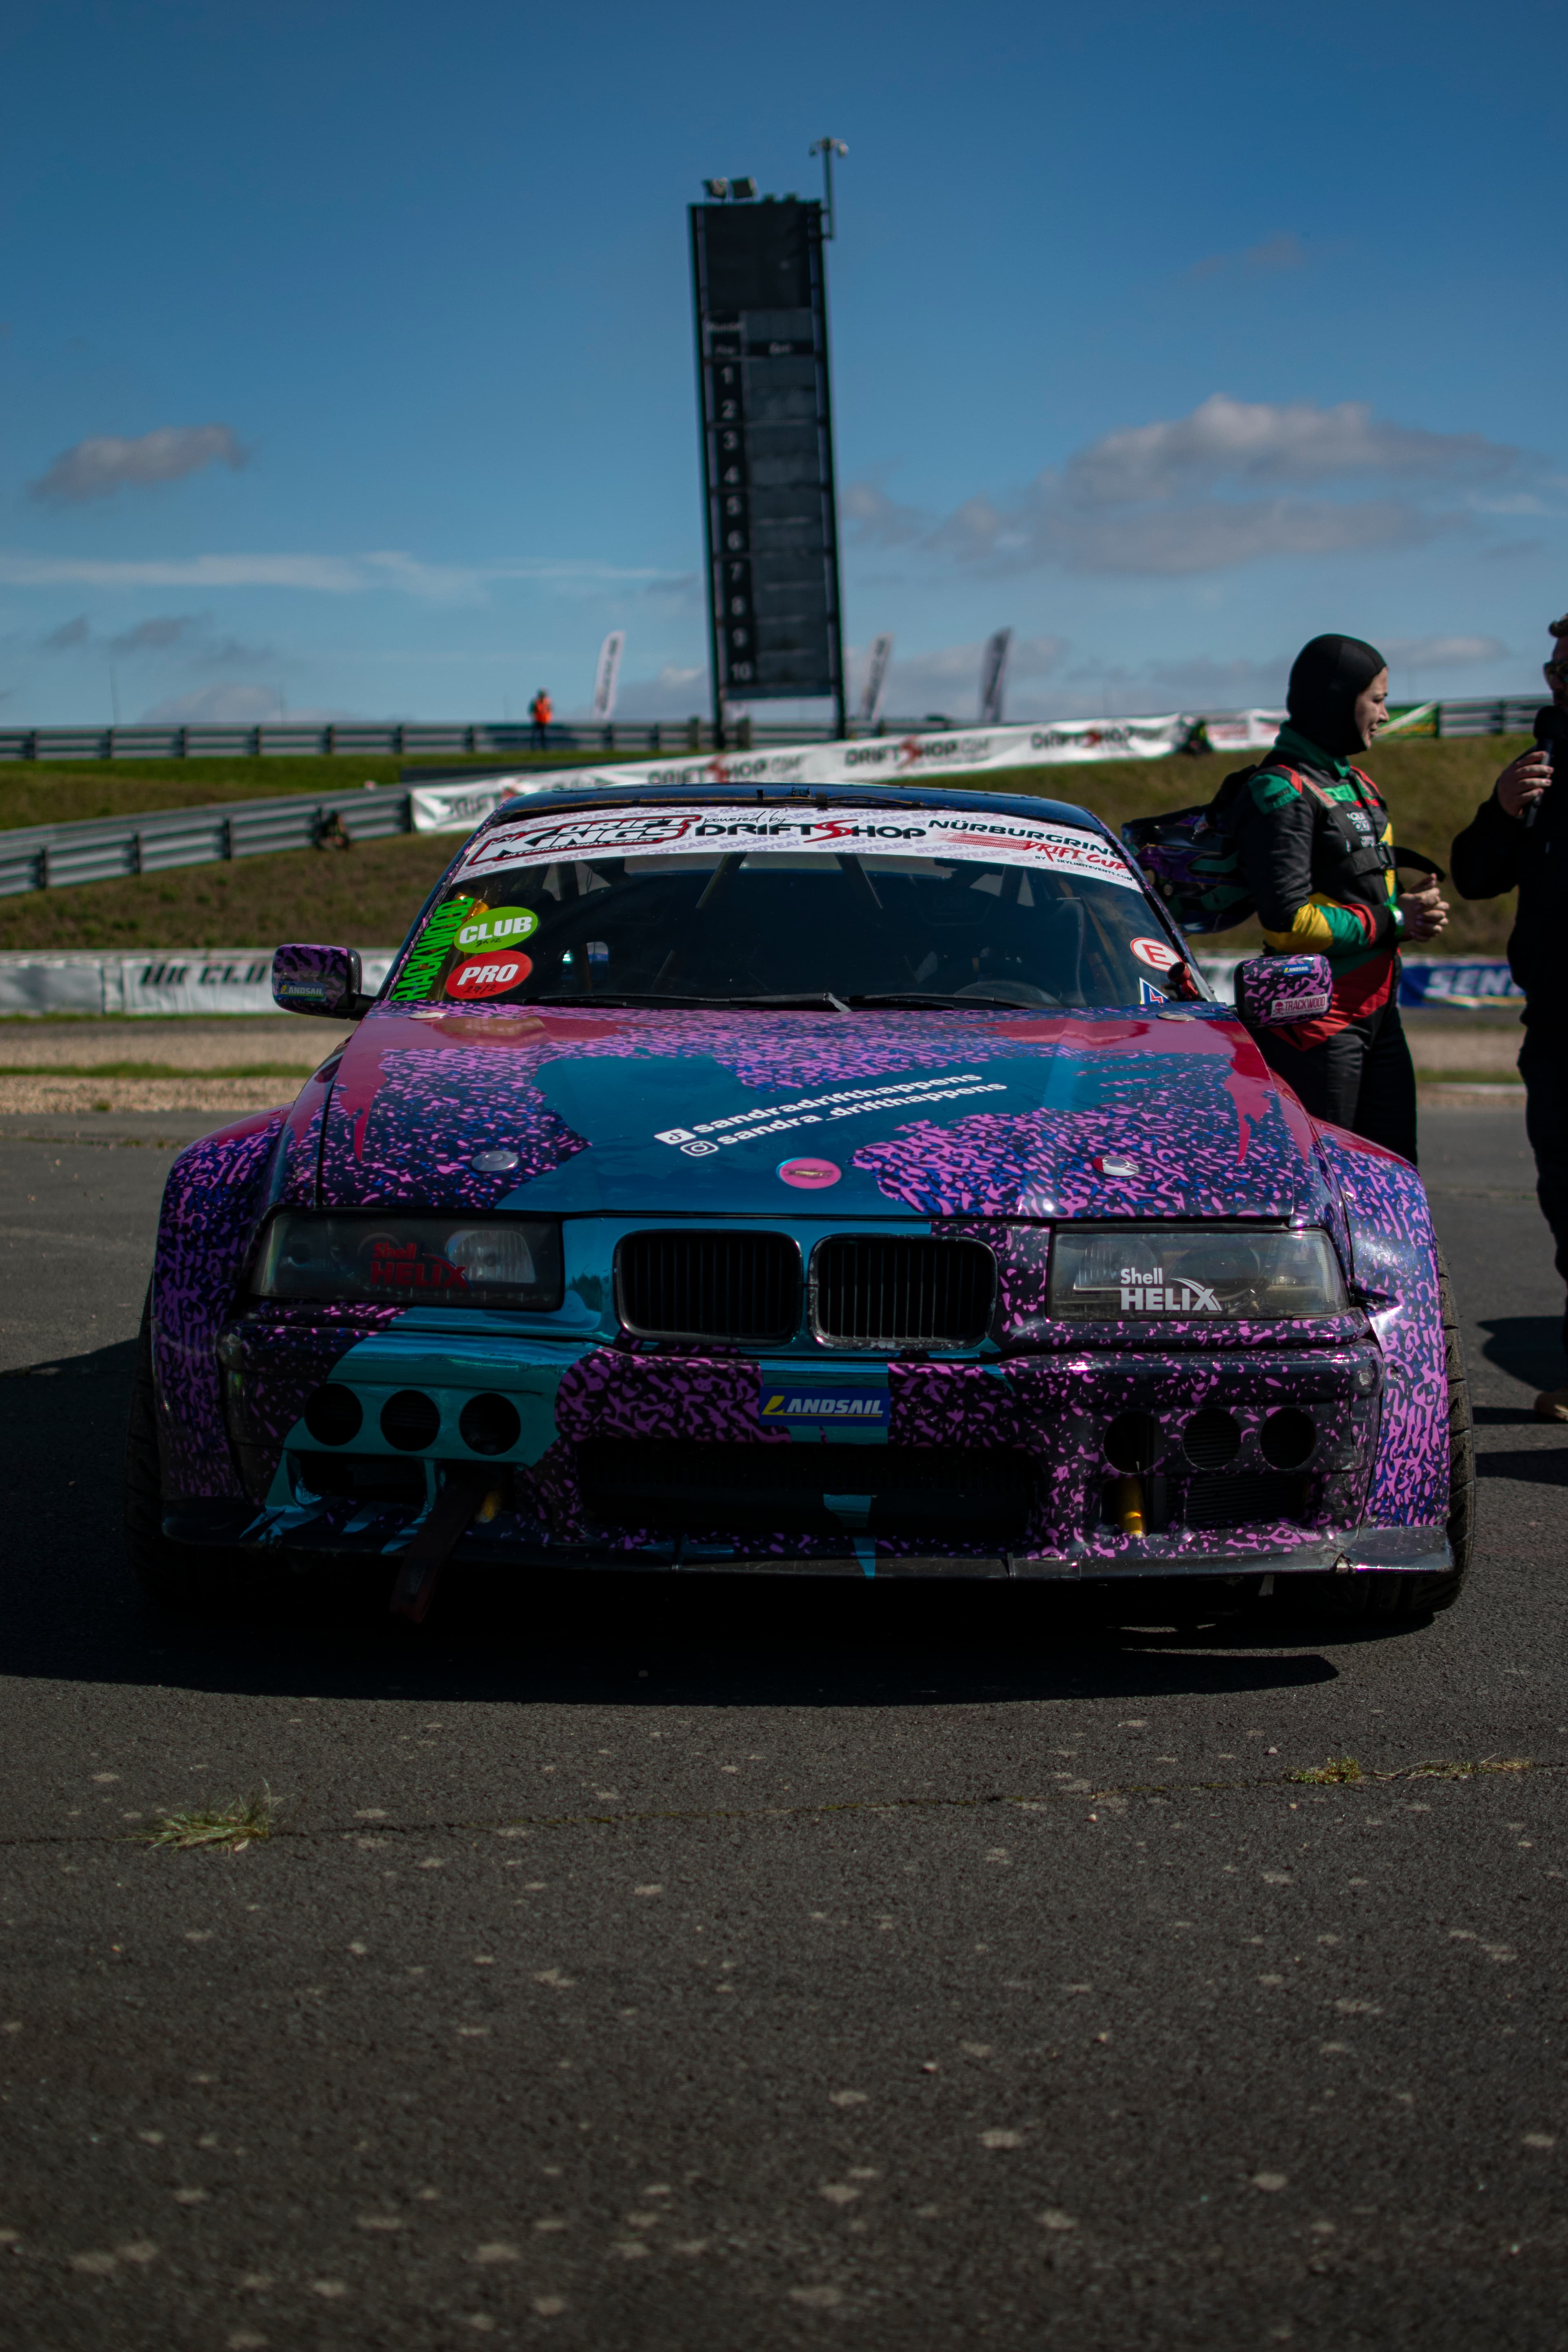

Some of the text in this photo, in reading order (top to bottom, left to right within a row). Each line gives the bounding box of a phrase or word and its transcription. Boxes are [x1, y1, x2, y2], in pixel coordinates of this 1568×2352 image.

[721, 367, 733, 384] 1
[722, 399, 737, 419] 2
[723, 430, 738, 450] 3
[724, 465, 739, 484] 4
[726, 496, 742, 515] 5
[727, 531, 743, 550] 6
[730, 562, 743, 580] 7
[732, 595, 746, 616] 8
[733, 627, 748, 647] 9
[731, 661, 753, 680] 10
[558, 817, 700, 834] DRIFT
[703, 811, 766, 826] powered
[768, 811, 790, 826] by
[695, 819, 927, 843] DRIFTSHOP
[472, 826, 684, 864] KINGS
[503, 842, 606, 858] INTERNATIONAL
[1023, 840, 1085, 862] DRIFT
[1085, 854, 1128, 871] CUP
[1056, 859, 1133, 882] SKYLIMITEVENTS.COM
[459, 916, 532, 944] CLUB
[1141, 944, 1172, 966] E
[457, 964, 519, 985] PRO
[281, 984, 323, 996] LANDSAIL
[693, 1074, 982, 1133] sandradrifthappens
[717, 1082, 1007, 1145] sandra_drifthappens
[372, 1242, 417, 1260] Shell
[371, 1260, 470, 1288] HELIX
[1120, 1268, 1163, 1285] Shell
[1120, 1287, 1223, 1311] HELIX
[762, 1395, 884, 1416] LANDSAIL
